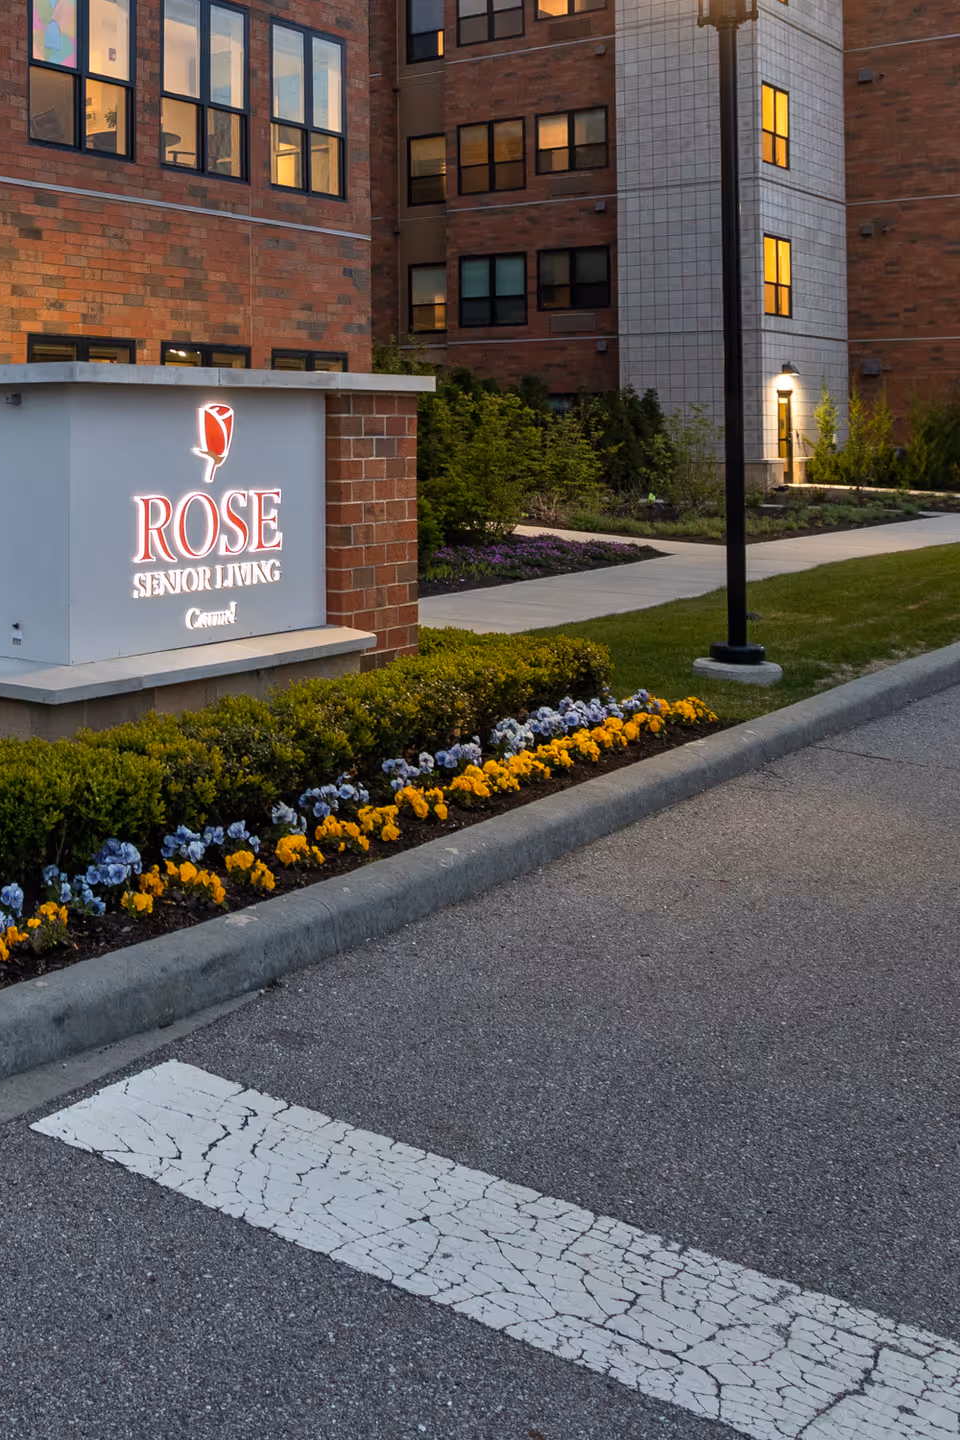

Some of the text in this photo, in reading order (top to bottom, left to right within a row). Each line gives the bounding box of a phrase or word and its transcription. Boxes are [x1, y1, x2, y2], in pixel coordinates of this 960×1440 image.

[132, 488, 283, 563] ROSE
[133, 559, 282, 599] SENIOR LIVING
